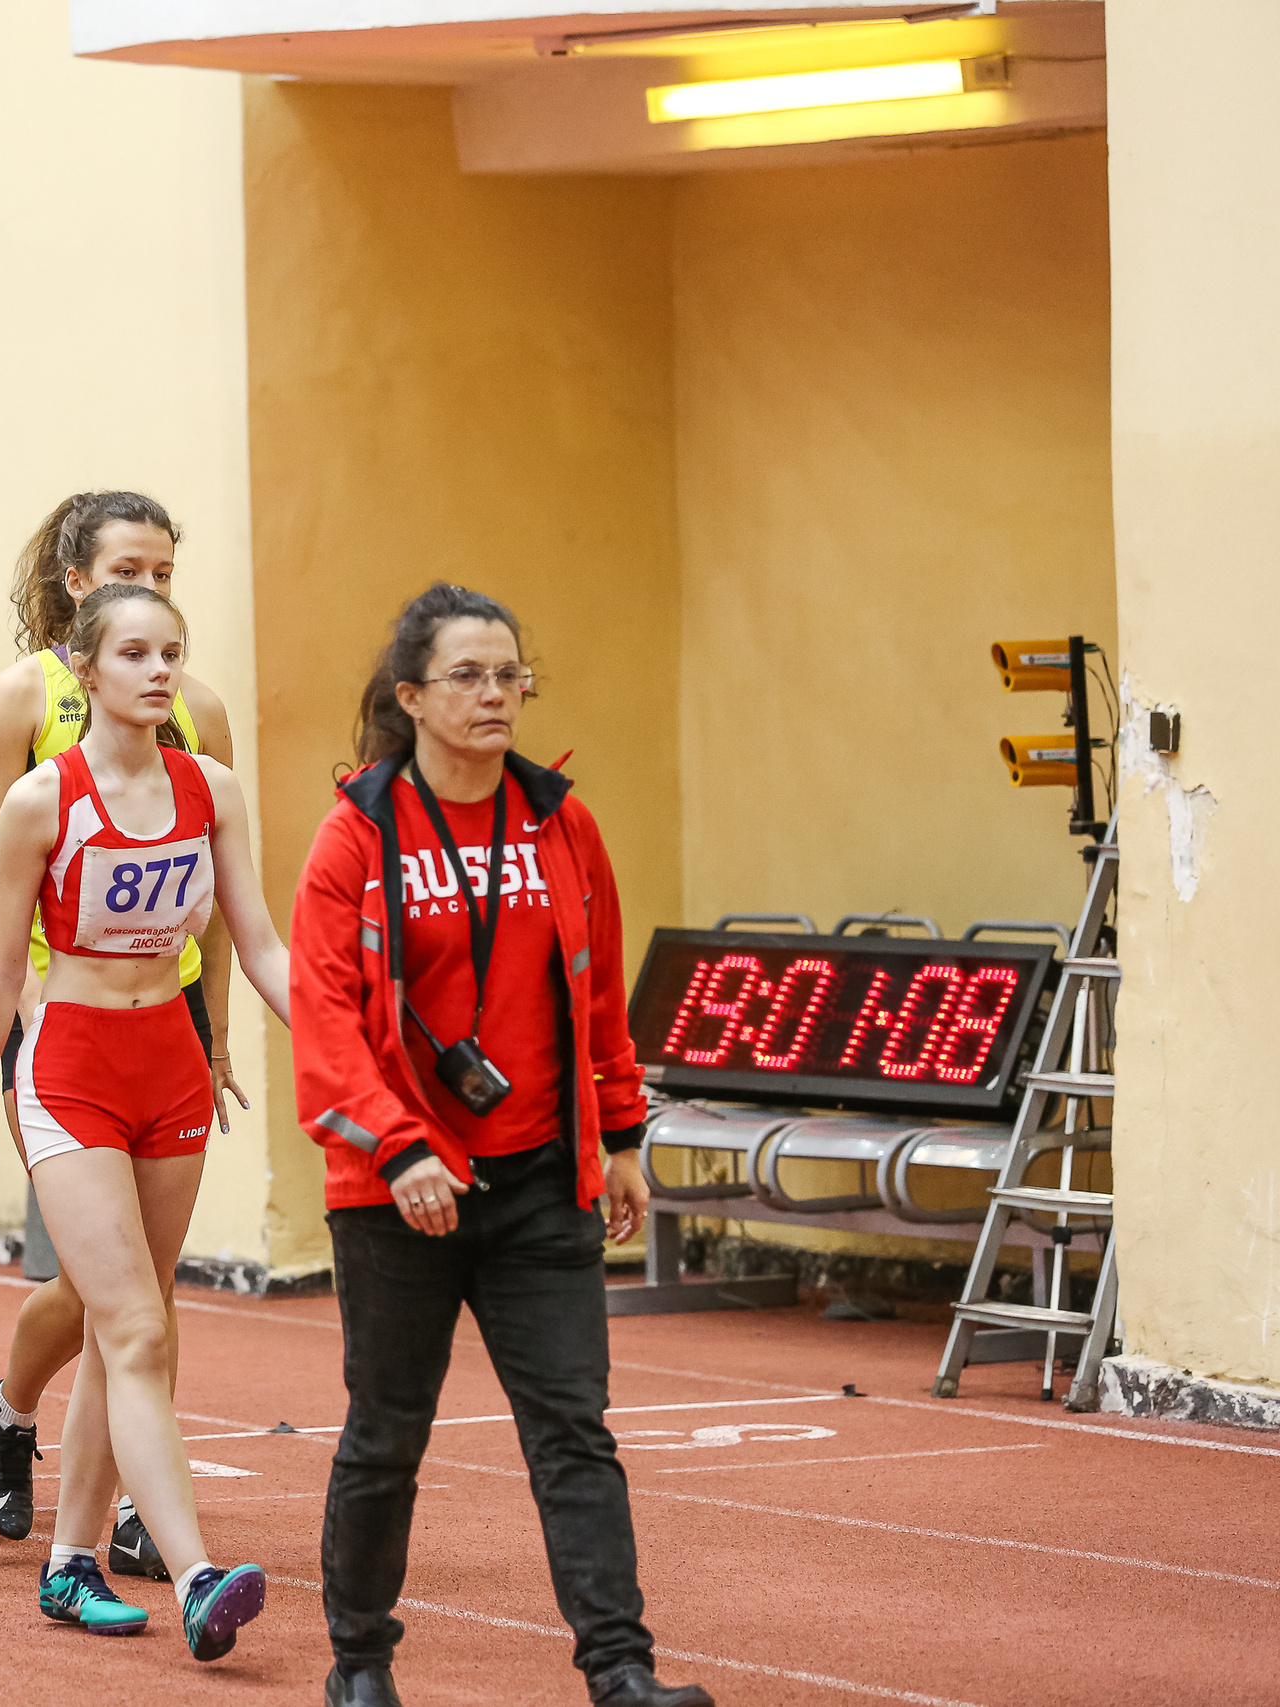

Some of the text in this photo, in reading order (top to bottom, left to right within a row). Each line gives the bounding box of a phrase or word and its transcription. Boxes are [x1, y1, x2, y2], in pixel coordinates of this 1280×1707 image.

[105, 852, 199, 914] 877
[128, 936, 175, 951] ДЮСШ
[178, 1125, 207, 1140] LIDER
